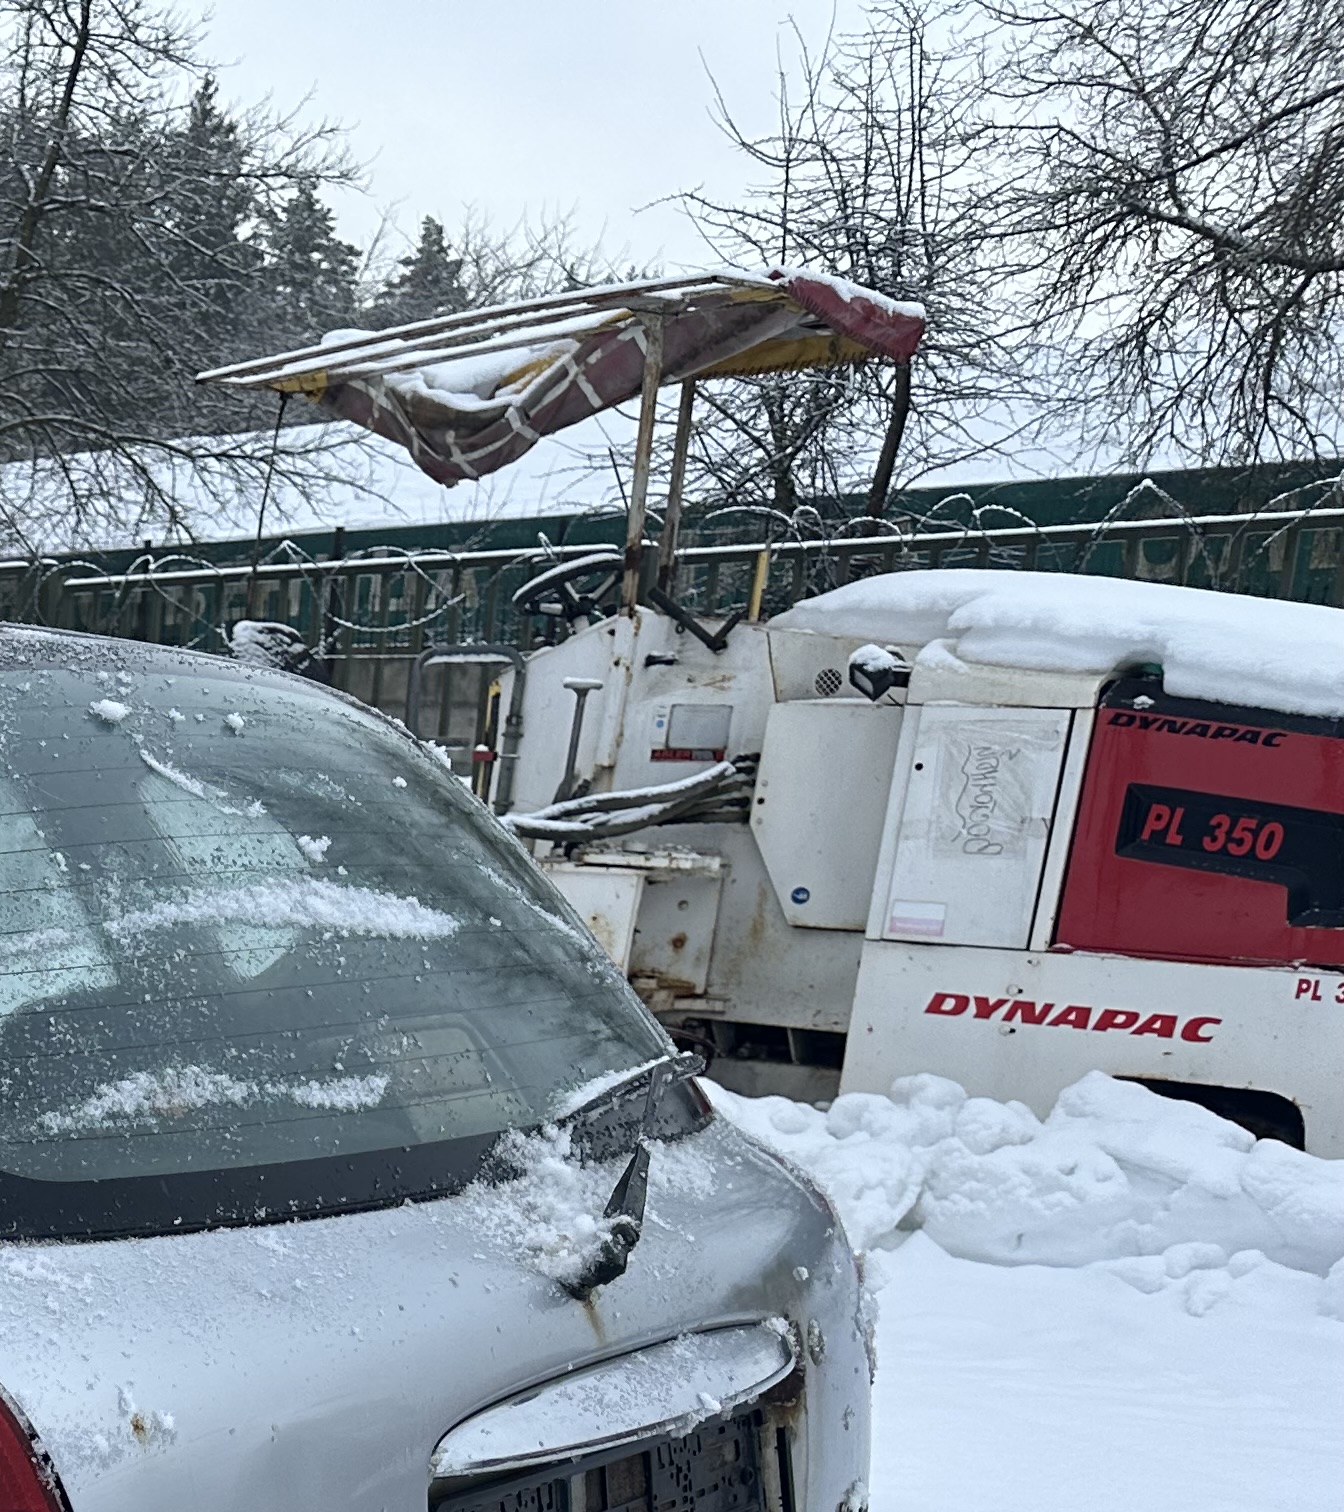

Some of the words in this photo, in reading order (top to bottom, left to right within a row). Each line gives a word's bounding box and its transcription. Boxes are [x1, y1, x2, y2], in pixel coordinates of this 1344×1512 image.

[1106, 711, 1289, 748] DYNAPAC
[1140, 802, 1185, 846] PL
[1201, 813, 1285, 861] 350
[1294, 978, 1323, 1002] PL
[923, 991, 1223, 1043] DYNAPAC
